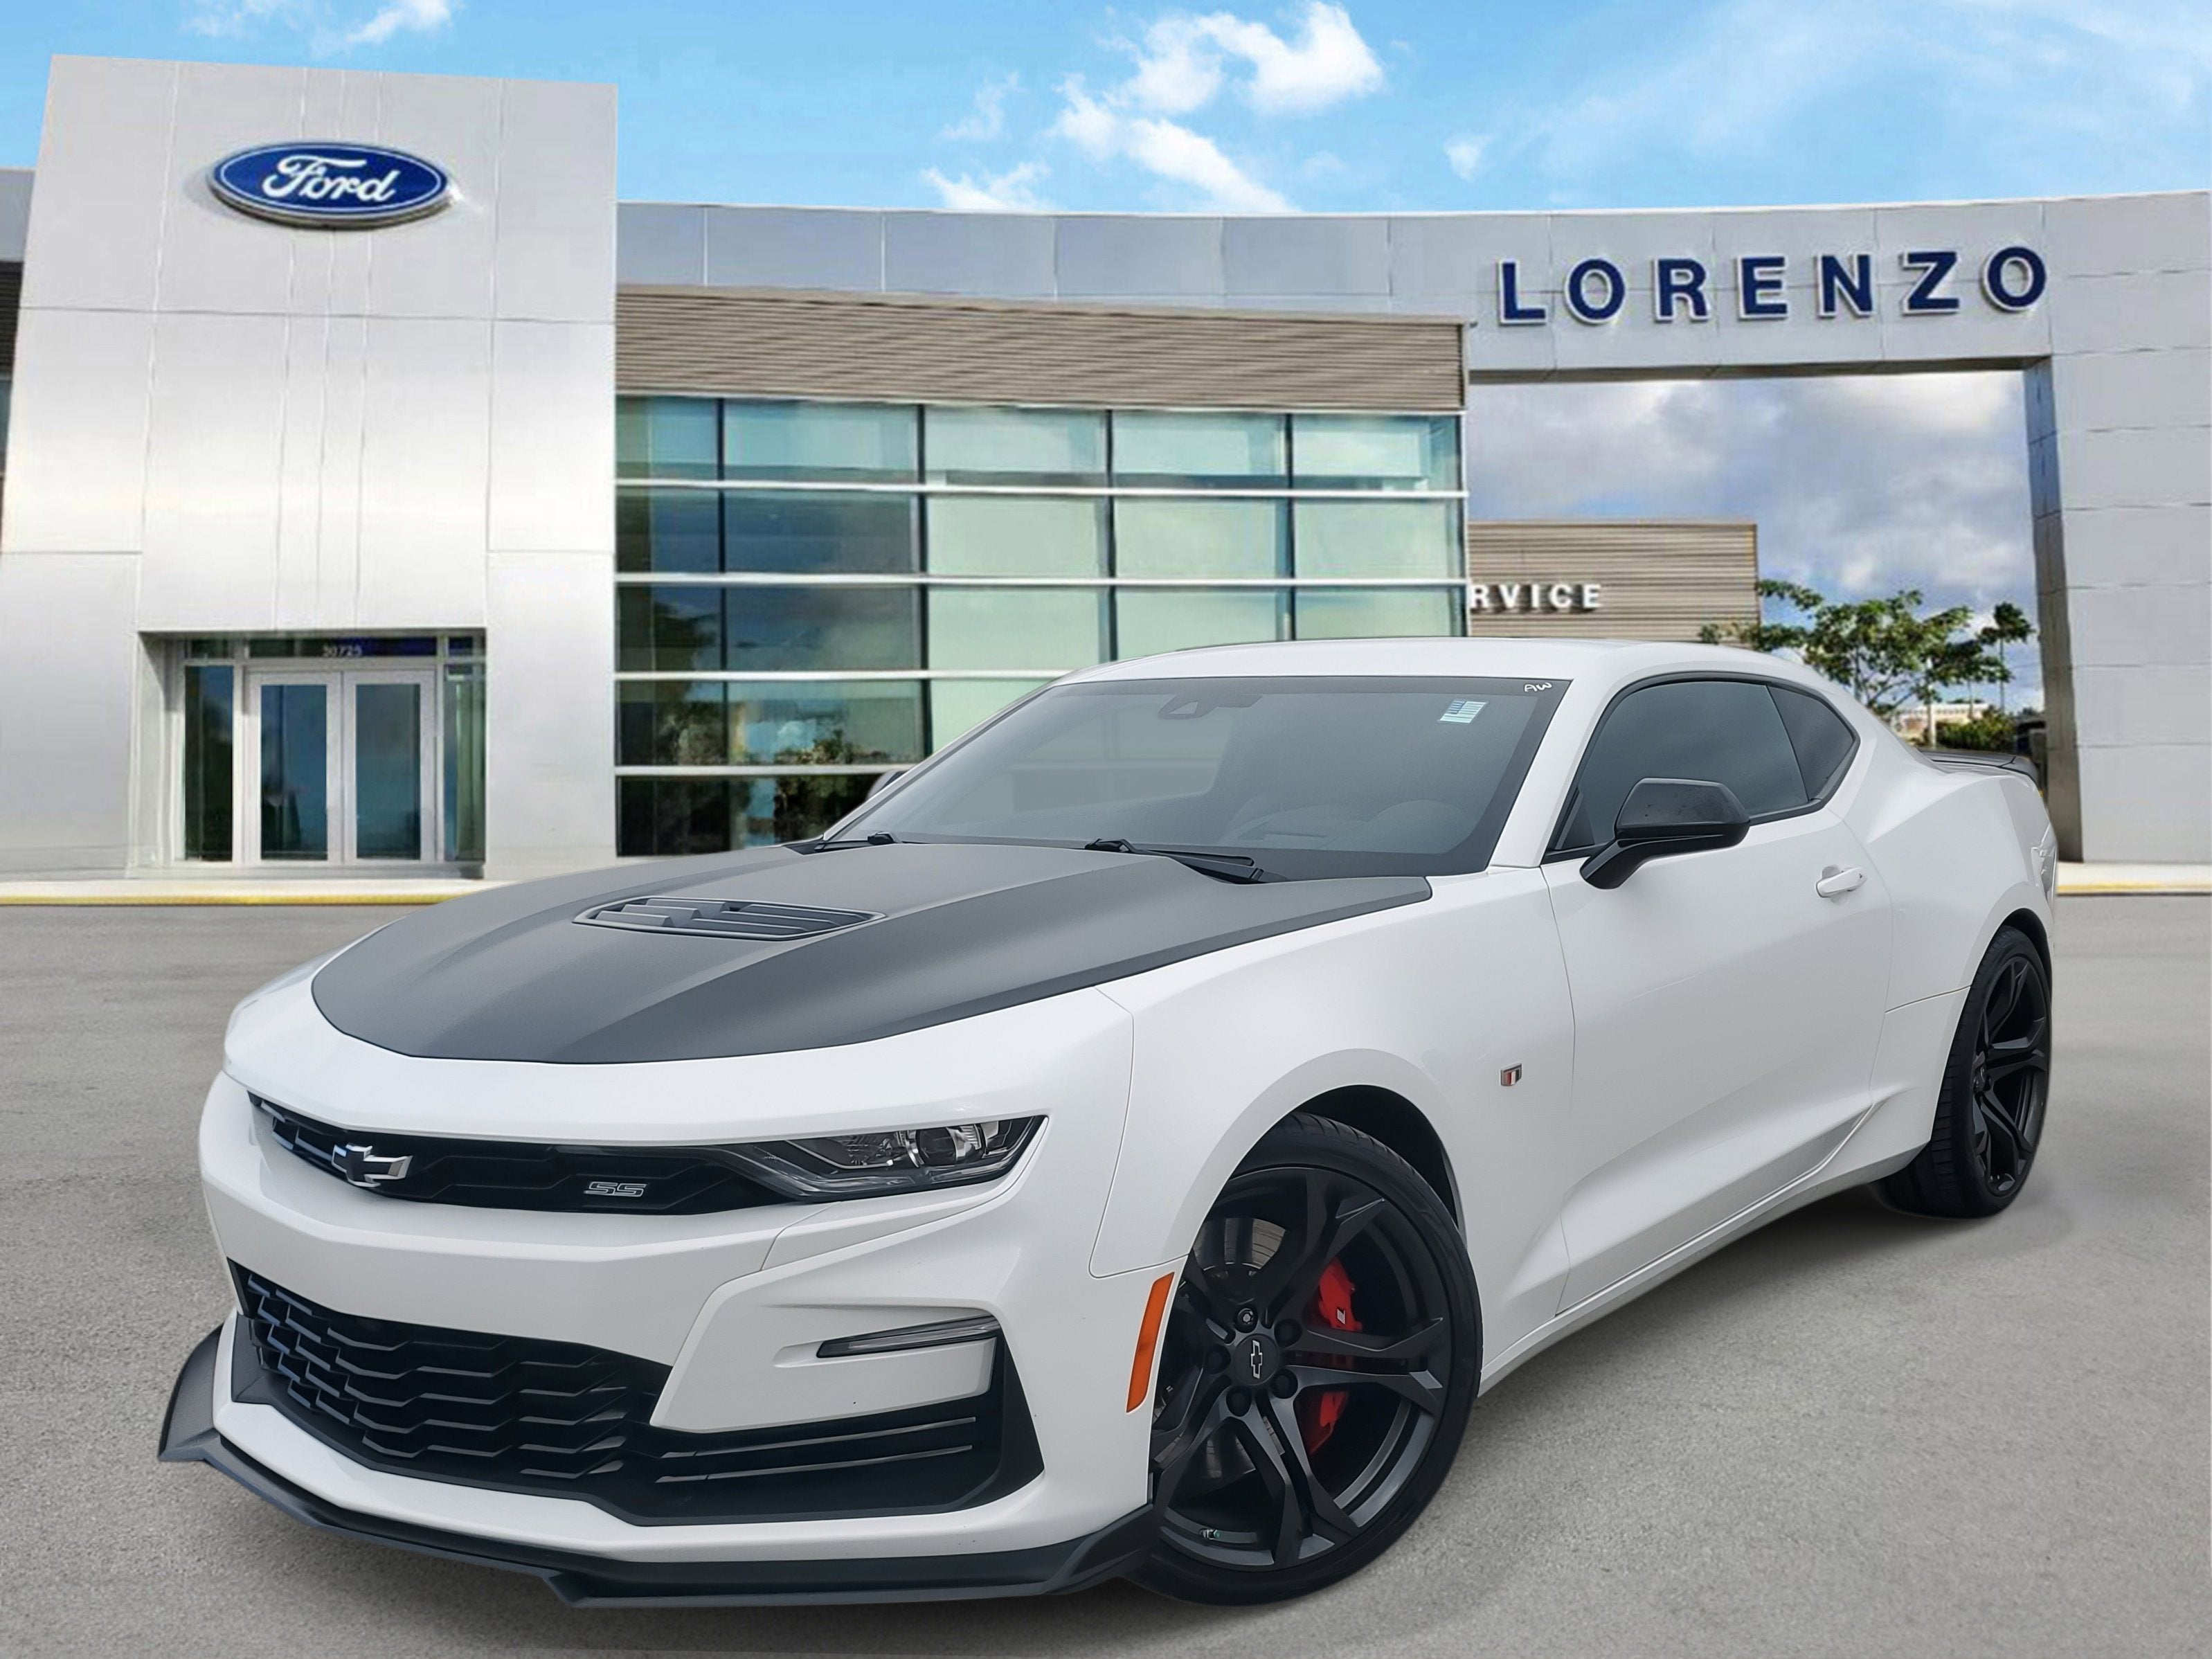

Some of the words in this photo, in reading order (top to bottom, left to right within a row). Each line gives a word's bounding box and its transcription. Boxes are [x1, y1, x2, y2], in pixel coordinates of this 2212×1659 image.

[261, 154, 402, 202] Ford
[1498, 246, 2047, 325] LORENZO
[1471, 583, 1602, 609] RVICE
[584, 1181, 647, 1197] SS
